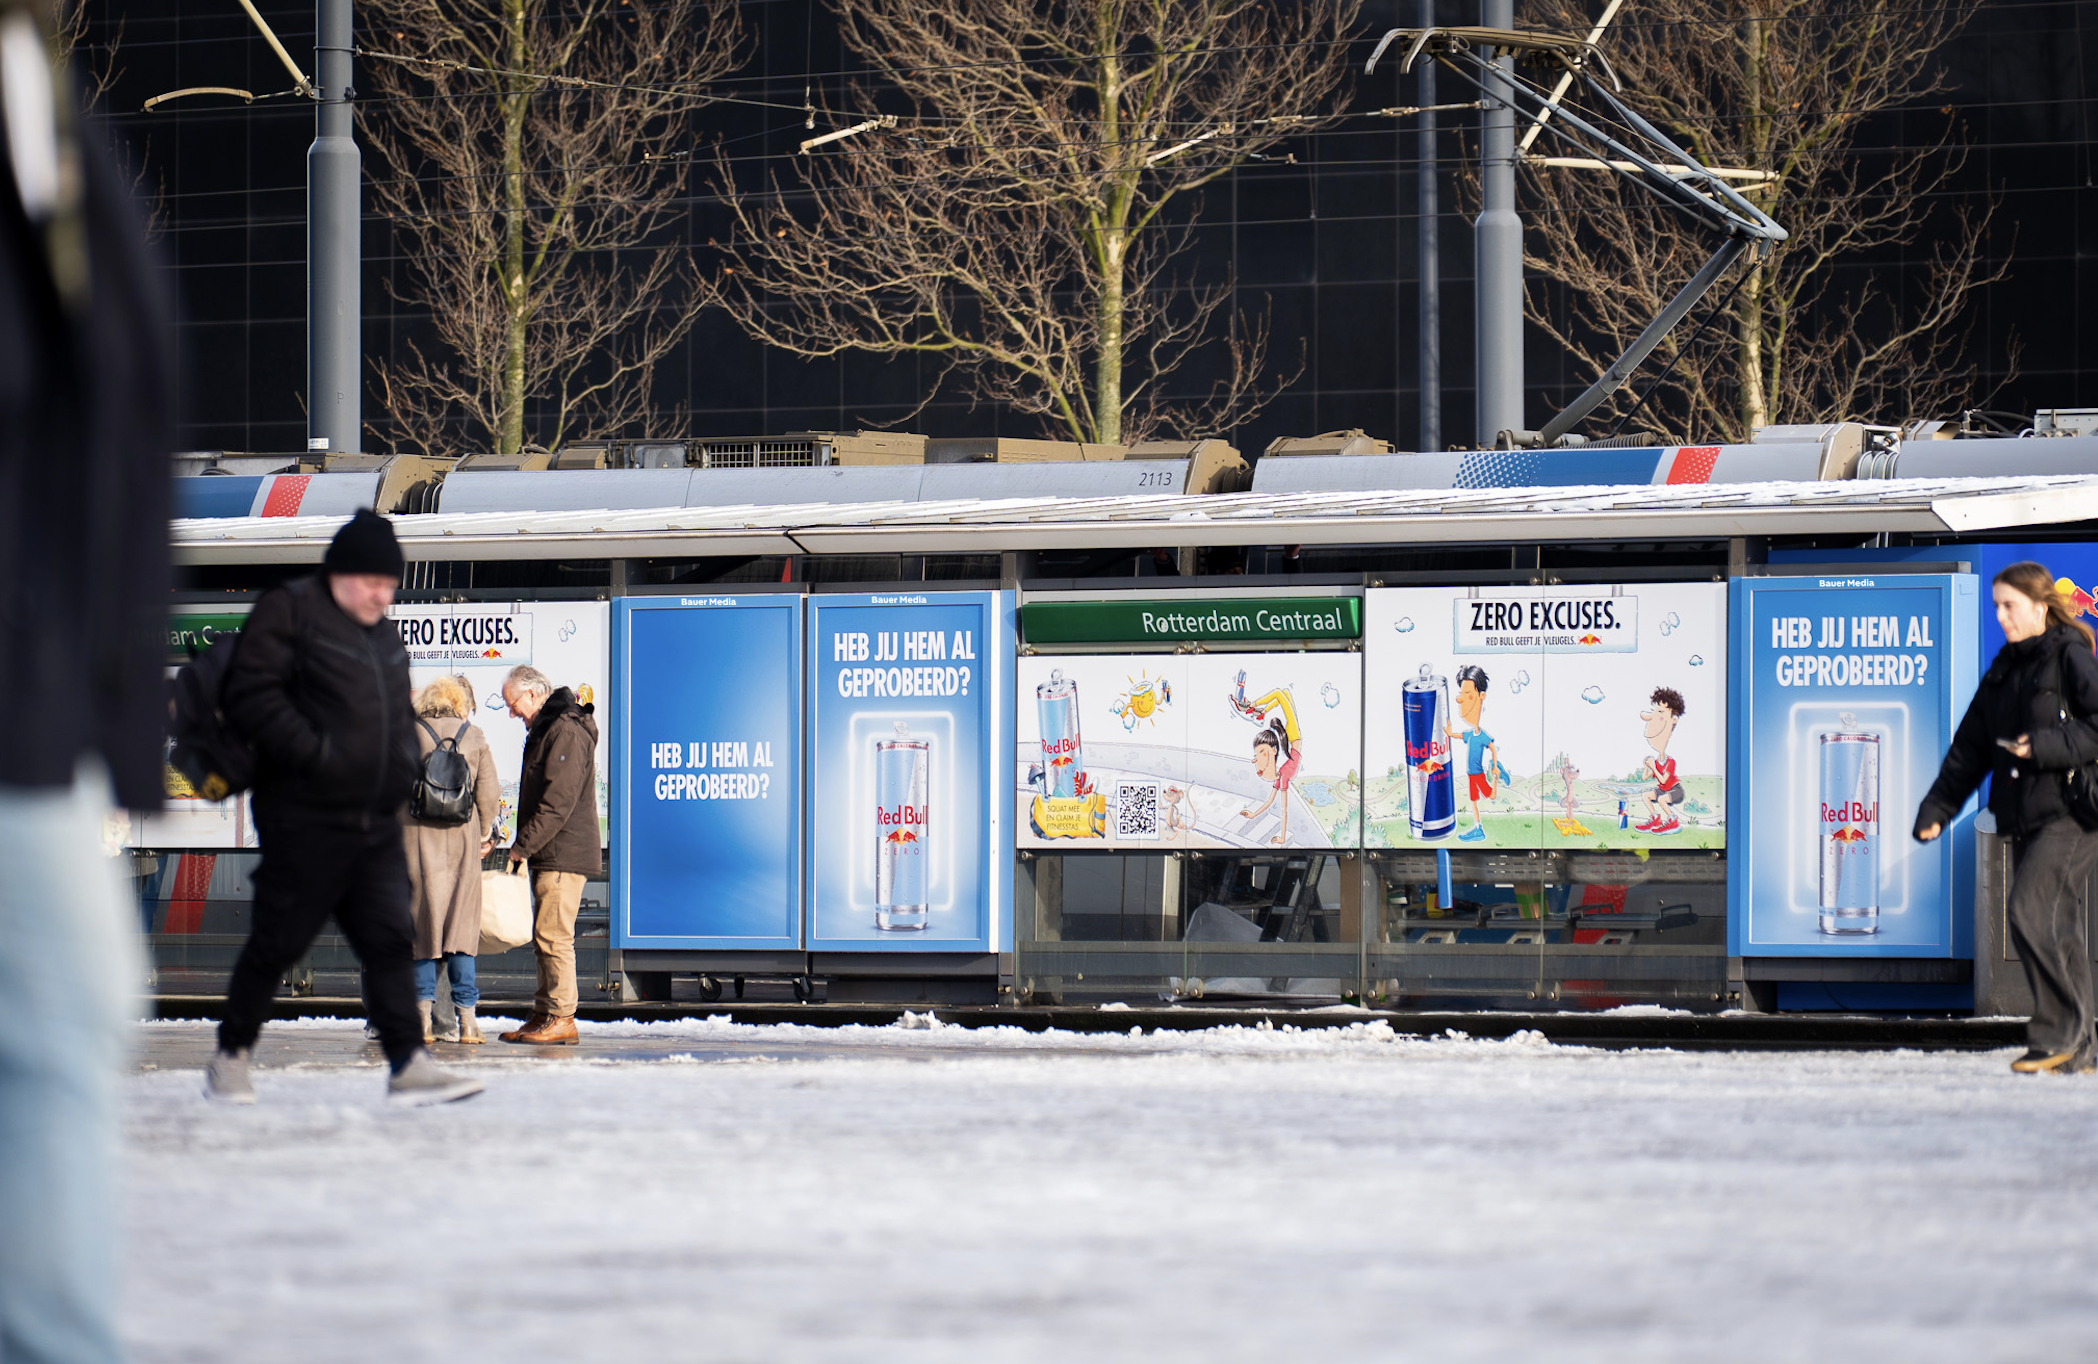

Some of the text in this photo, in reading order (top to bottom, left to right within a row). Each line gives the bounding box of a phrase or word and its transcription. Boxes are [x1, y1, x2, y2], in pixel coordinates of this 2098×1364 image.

[1138, 472, 1173, 486] 2113
[1819, 579, 1875, 587] Bauer Media
[681, 598, 737, 606] Bauer Media
[871, 596, 927, 604] Bauer Media
[1142, 607, 1343, 634] Rotterdam Centraal
[1470, 600, 1621, 631] ZERO EXCUSES.
[440, 617, 519, 645] EXCUSES.
[1486, 635, 1577, 647] RED BULL GEEFT JE VLEUGELS.
[1772, 616, 1933, 649] HEB JIJ HEM AL
[413, 650, 426, 660] BULL
[426, 650, 443, 660] GEEFT
[443, 650, 449, 660] JE
[452, 650, 480, 659] VLEUGELS.
[834, 630, 976, 662] HEB JIJ HEM AL
[1776, 653, 1928, 687] GEPROBEERD?
[838, 665, 971, 698] GEPROBEERD?
[1042, 732, 1081, 754] Red Bull
[1406, 737, 1451, 759] Red Bull
[651, 741, 774, 769] HEB JIJ HEM AL
[654, 772, 770, 800] GEPROBEERD?
[877, 804, 928, 825] Red Bull
[1055, 814, 1074, 822] CLAIM
[1075, 814, 1081, 822] JE
[1821, 801, 1879, 823] Red Bull
[884, 847, 920, 856] ZERO
[1829, 846, 1870, 855] ZERO
